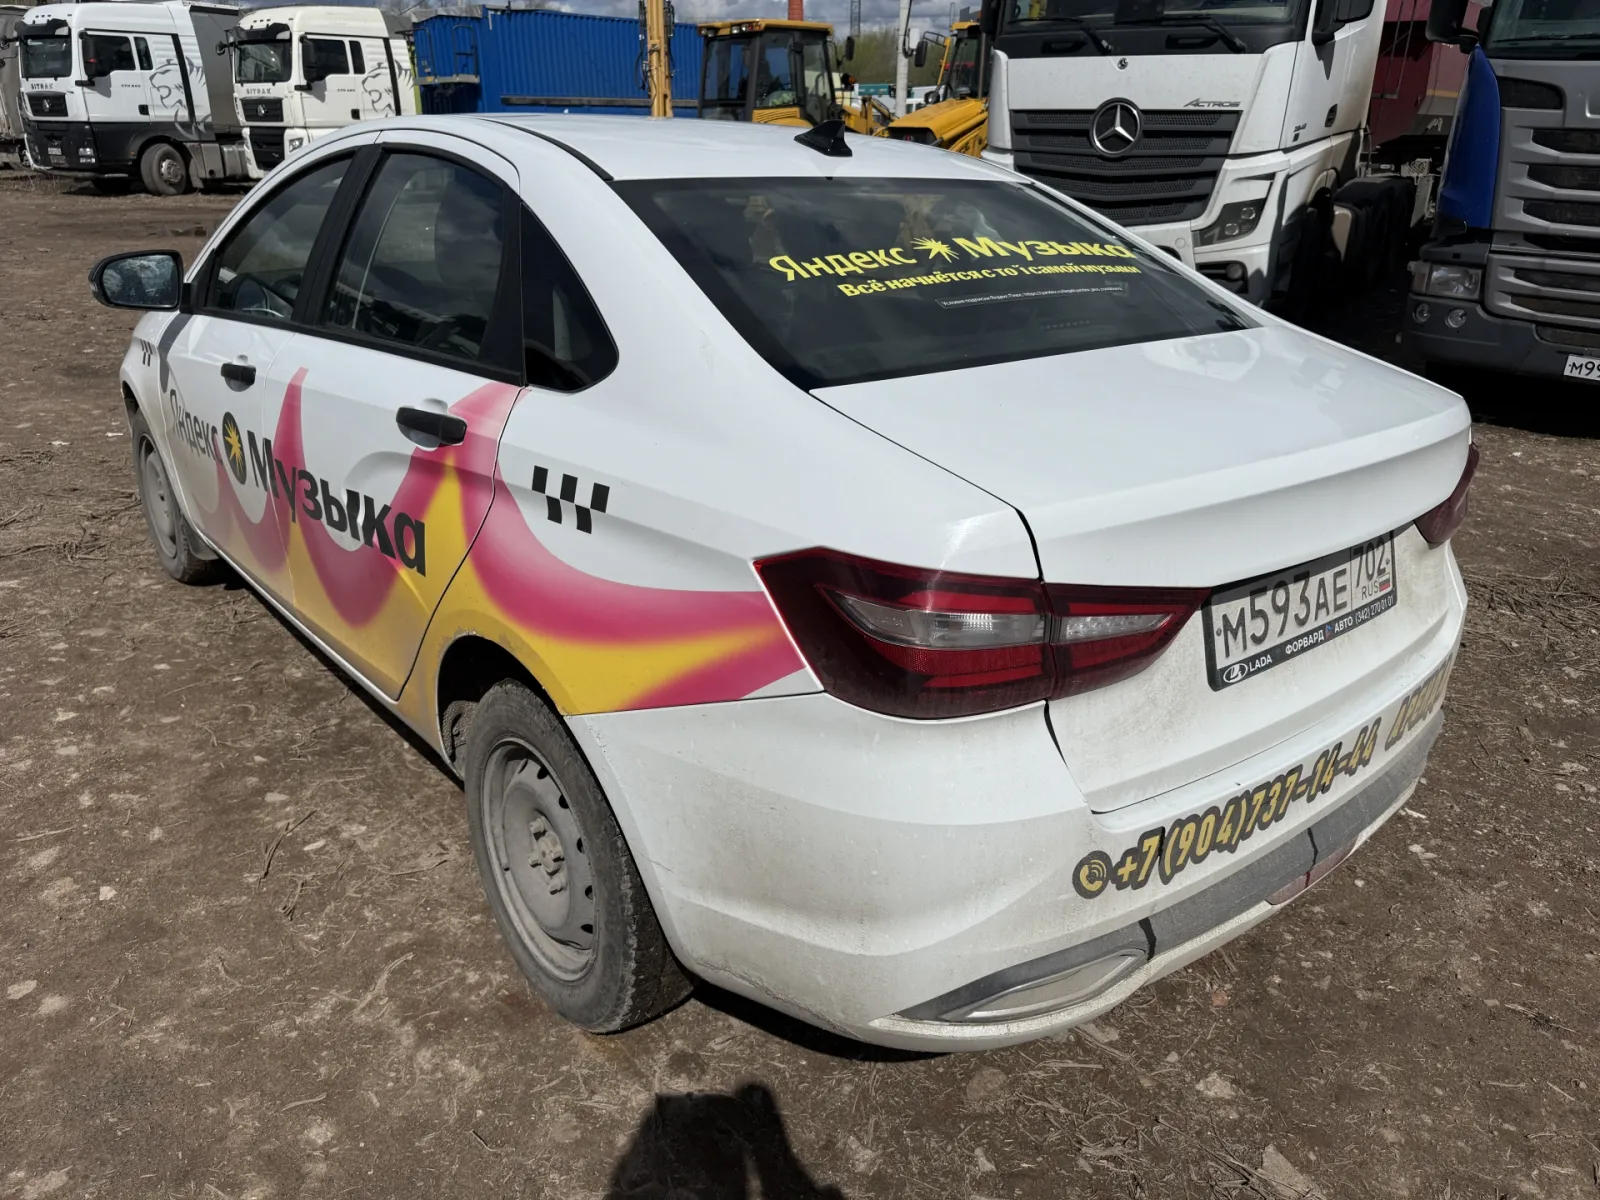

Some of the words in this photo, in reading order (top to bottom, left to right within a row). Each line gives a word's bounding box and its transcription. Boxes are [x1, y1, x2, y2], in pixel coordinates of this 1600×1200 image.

[1183, 98, 1241, 108] ACTROS
[768, 248, 918, 281] Яндекс
[951, 236, 1137, 261] Музыка
[837, 279, 887, 296] Всё
[885, 269, 984, 289] начнётся
[981, 269, 996, 278] с
[1028, 263, 1083, 275] самой
[1080, 264, 1142, 275] музыки
[169, 389, 224, 467] Яндекс
[247, 430, 427, 578] Музыка
[1361, 580, 1380, 601] RUS
[1285, 629, 1325, 655] ФОРВАРД
[1334, 616, 1354, 634] АВТО
[1249, 653, 1273, 672] LADA
